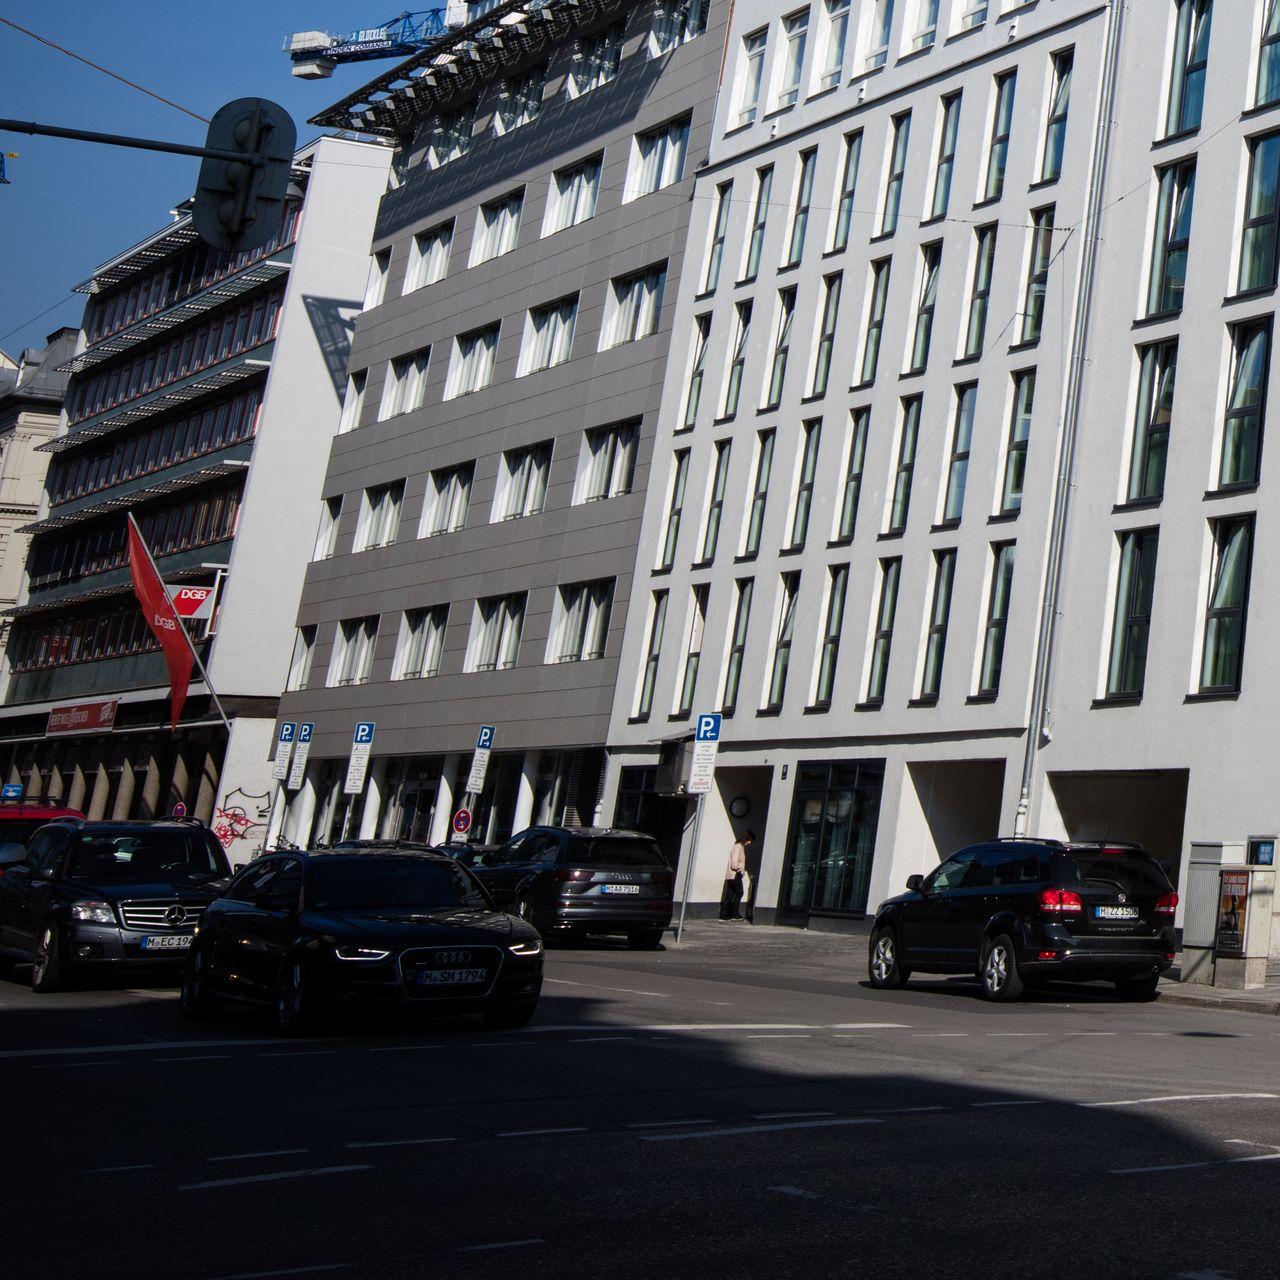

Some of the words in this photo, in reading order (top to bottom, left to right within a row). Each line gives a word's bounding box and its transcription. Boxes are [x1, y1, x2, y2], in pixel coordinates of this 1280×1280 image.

[181, 589, 207, 600] DGB
[154, 614, 176, 630] DGB
[281, 724, 292, 740] P
[300, 724, 310, 740] P
[356, 725, 369, 741] P
[699, 717, 715, 738] P
[479, 728, 490, 746] P
[160, 937, 174, 947] EC
